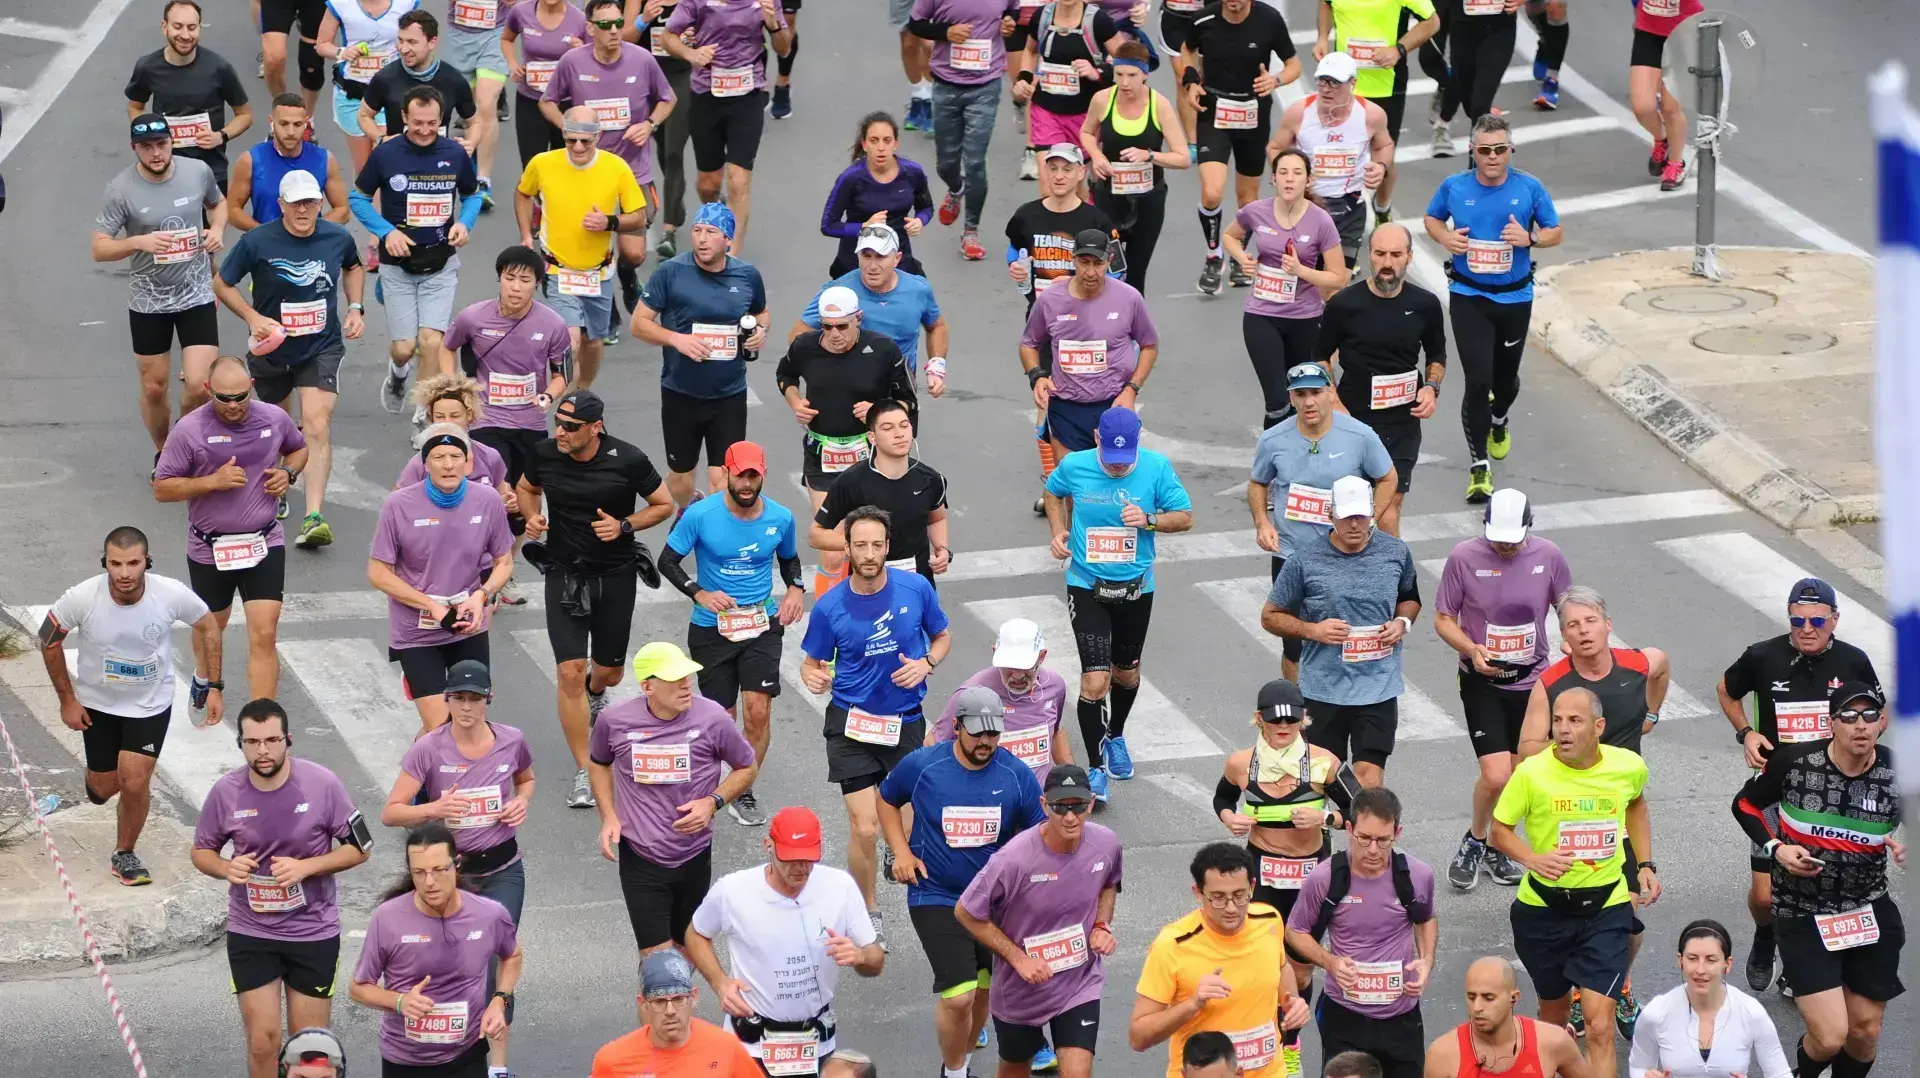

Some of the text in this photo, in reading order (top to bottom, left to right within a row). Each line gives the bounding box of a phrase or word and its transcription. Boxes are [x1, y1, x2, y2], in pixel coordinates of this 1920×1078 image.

[407, 181, 456, 191] JERUSALEM
[419, 204, 437, 215] 6371
[1033, 234, 1062, 248] TEAM
[1477, 252, 1499, 264] 5482
[1385, 385, 1404, 399] 8601
[832, 452, 854, 464] 8418
[1299, 501, 1320, 513] 4519
[1099, 538, 1119, 551] 5481
[731, 617, 753, 629] 5559
[1357, 639, 1378, 652] 8525
[1500, 637, 1521, 650] 6761
[120, 665, 138, 675] 688
[860, 719, 882, 732] 5560
[1792, 717, 1815, 730] 4215
[1011, 742, 1035, 756] 6439
[635, 757, 671, 770] A 5989
[1554, 799, 1572, 811] TRI
[1578, 798, 1595, 811] TLV
[945, 822, 980, 835] C 7330
[1811, 825, 1870, 844] México
[1561, 834, 1600, 848] A 6079
[1264, 863, 1299, 877] C 8447
[259, 887, 284, 900] 5982
[1833, 918, 1858, 933] 6975
[1042, 943, 1068, 958] 6664
[786, 955, 806, 965] 2050
[773, 970, 790, 979] צריך
[1358, 975, 1384, 989] 6843
[420, 1018, 447, 1031] 7489
[775, 1047, 798, 1060] 6663
[1236, 1042, 1259, 1058] 5106
